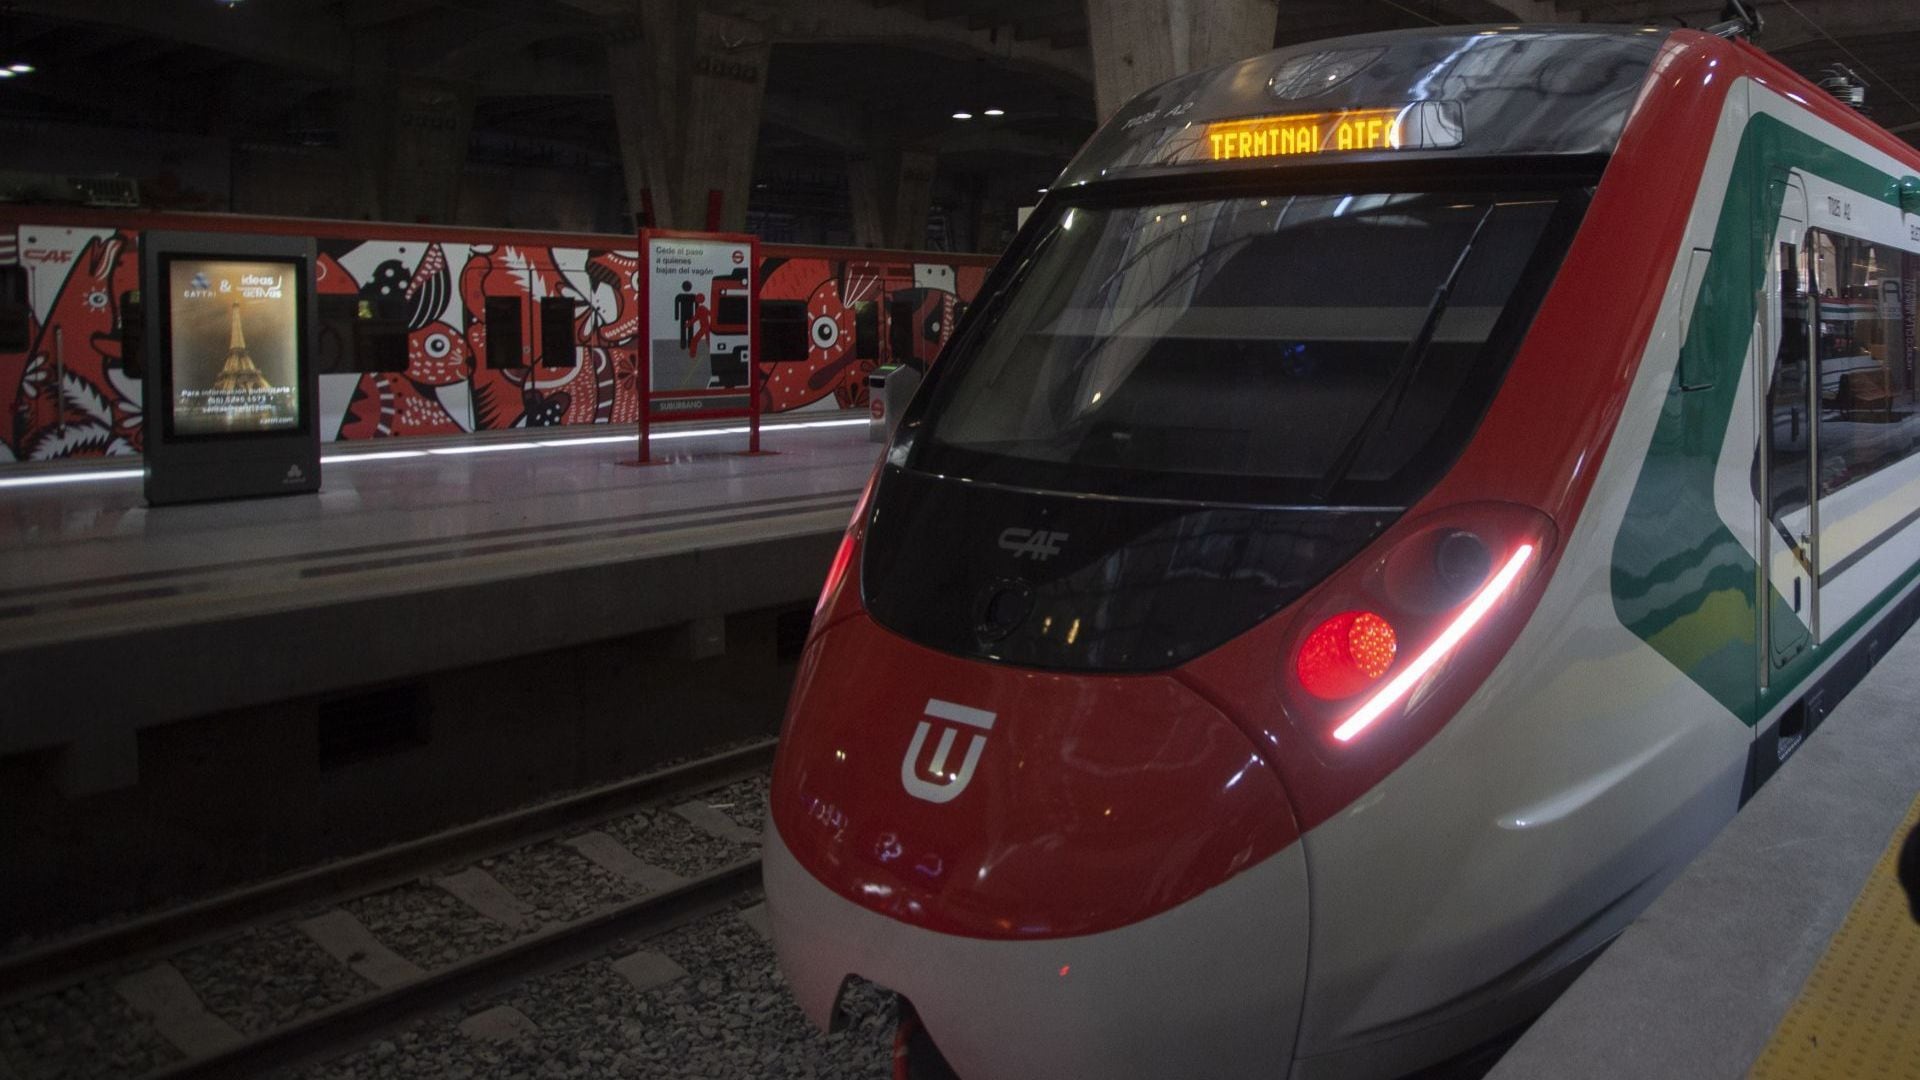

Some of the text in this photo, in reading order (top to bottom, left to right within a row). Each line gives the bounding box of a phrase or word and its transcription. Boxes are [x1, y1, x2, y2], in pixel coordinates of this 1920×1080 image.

[23, 249, 73, 263] CAF
[655, 246, 704, 256] Cede el paso
[662, 257, 692, 266] quienes
[655, 266, 714, 276] bajan del vagón
[241, 274, 274, 286] ideas
[220, 279, 232, 293] &
[242, 286, 282, 298] activas
[181, 389, 200, 397] Para
[659, 401, 703, 411] SUBURBANO
[998, 527, 1070, 561] CAF
